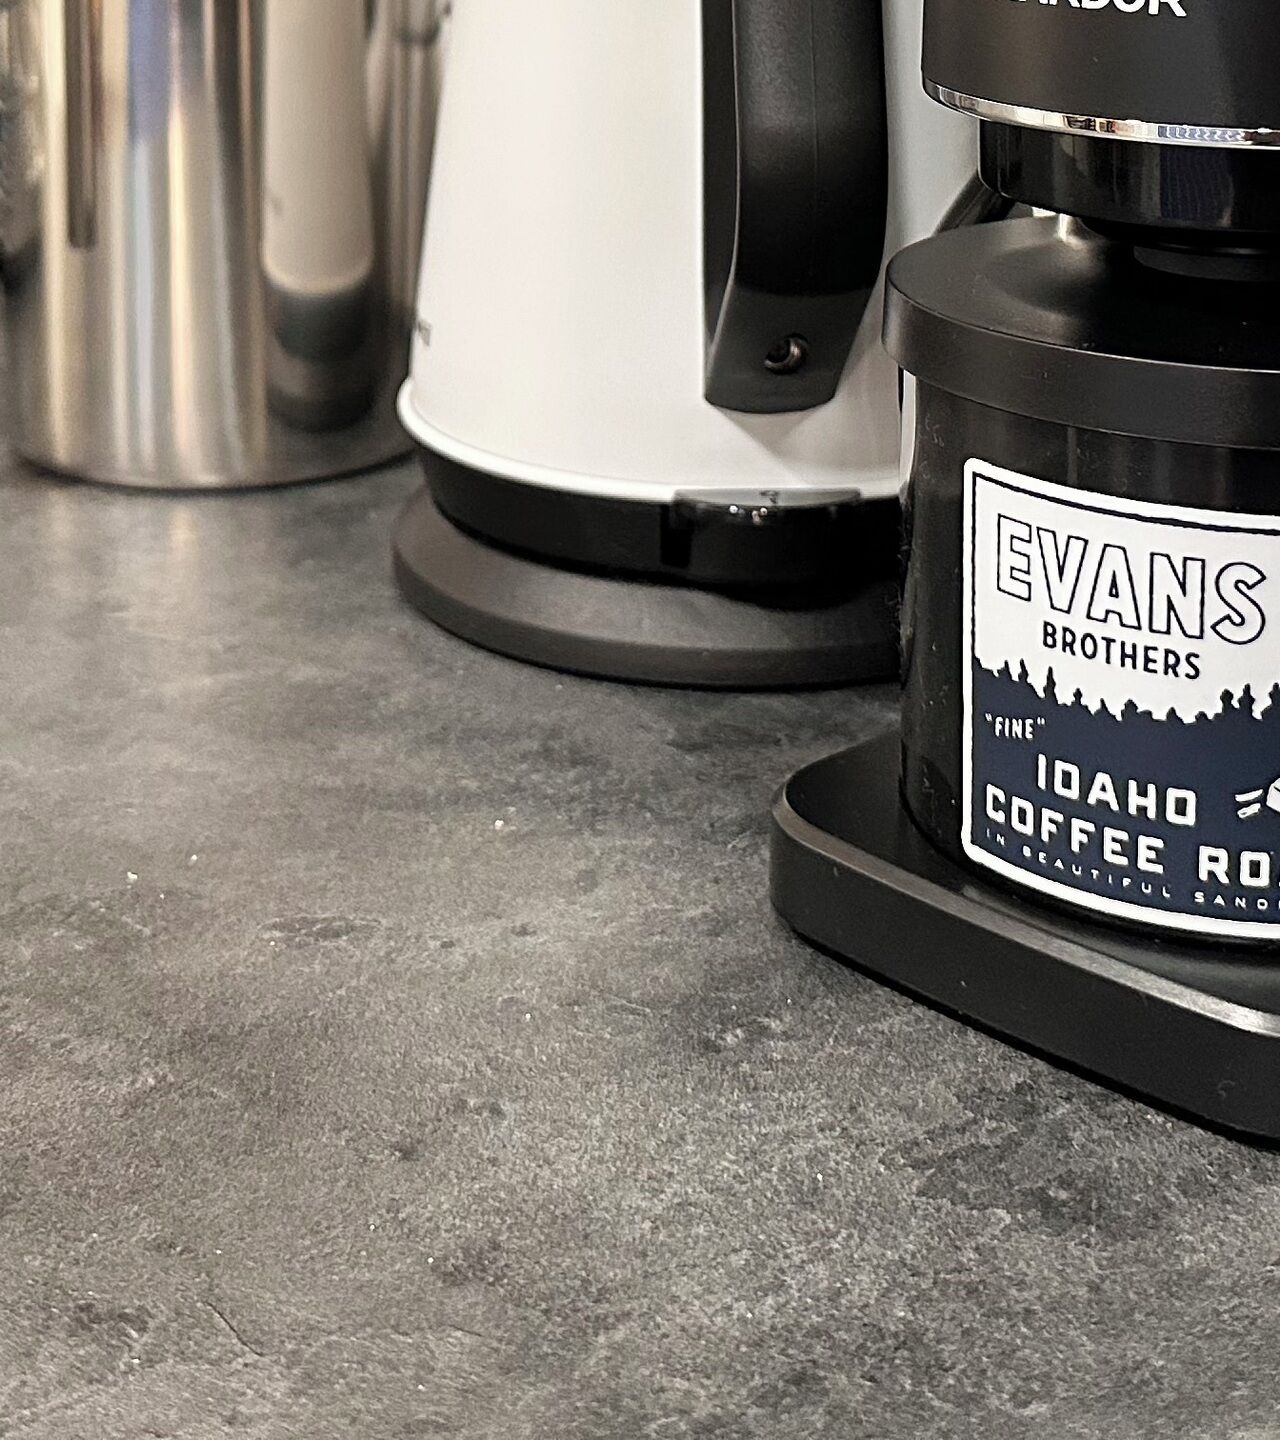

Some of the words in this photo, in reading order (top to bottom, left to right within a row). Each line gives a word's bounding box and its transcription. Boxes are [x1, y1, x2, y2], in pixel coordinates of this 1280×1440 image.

[996, 513, 1267, 645] EVANS
[1042, 621, 1202, 680] BROTHERS
[1036, 753, 1197, 827] IDAHO
[985, 784, 1165, 875] COFFEE
[986, 828, 1006, 846] IN
[1022, 845, 1171, 899] BEAUTIFUL
